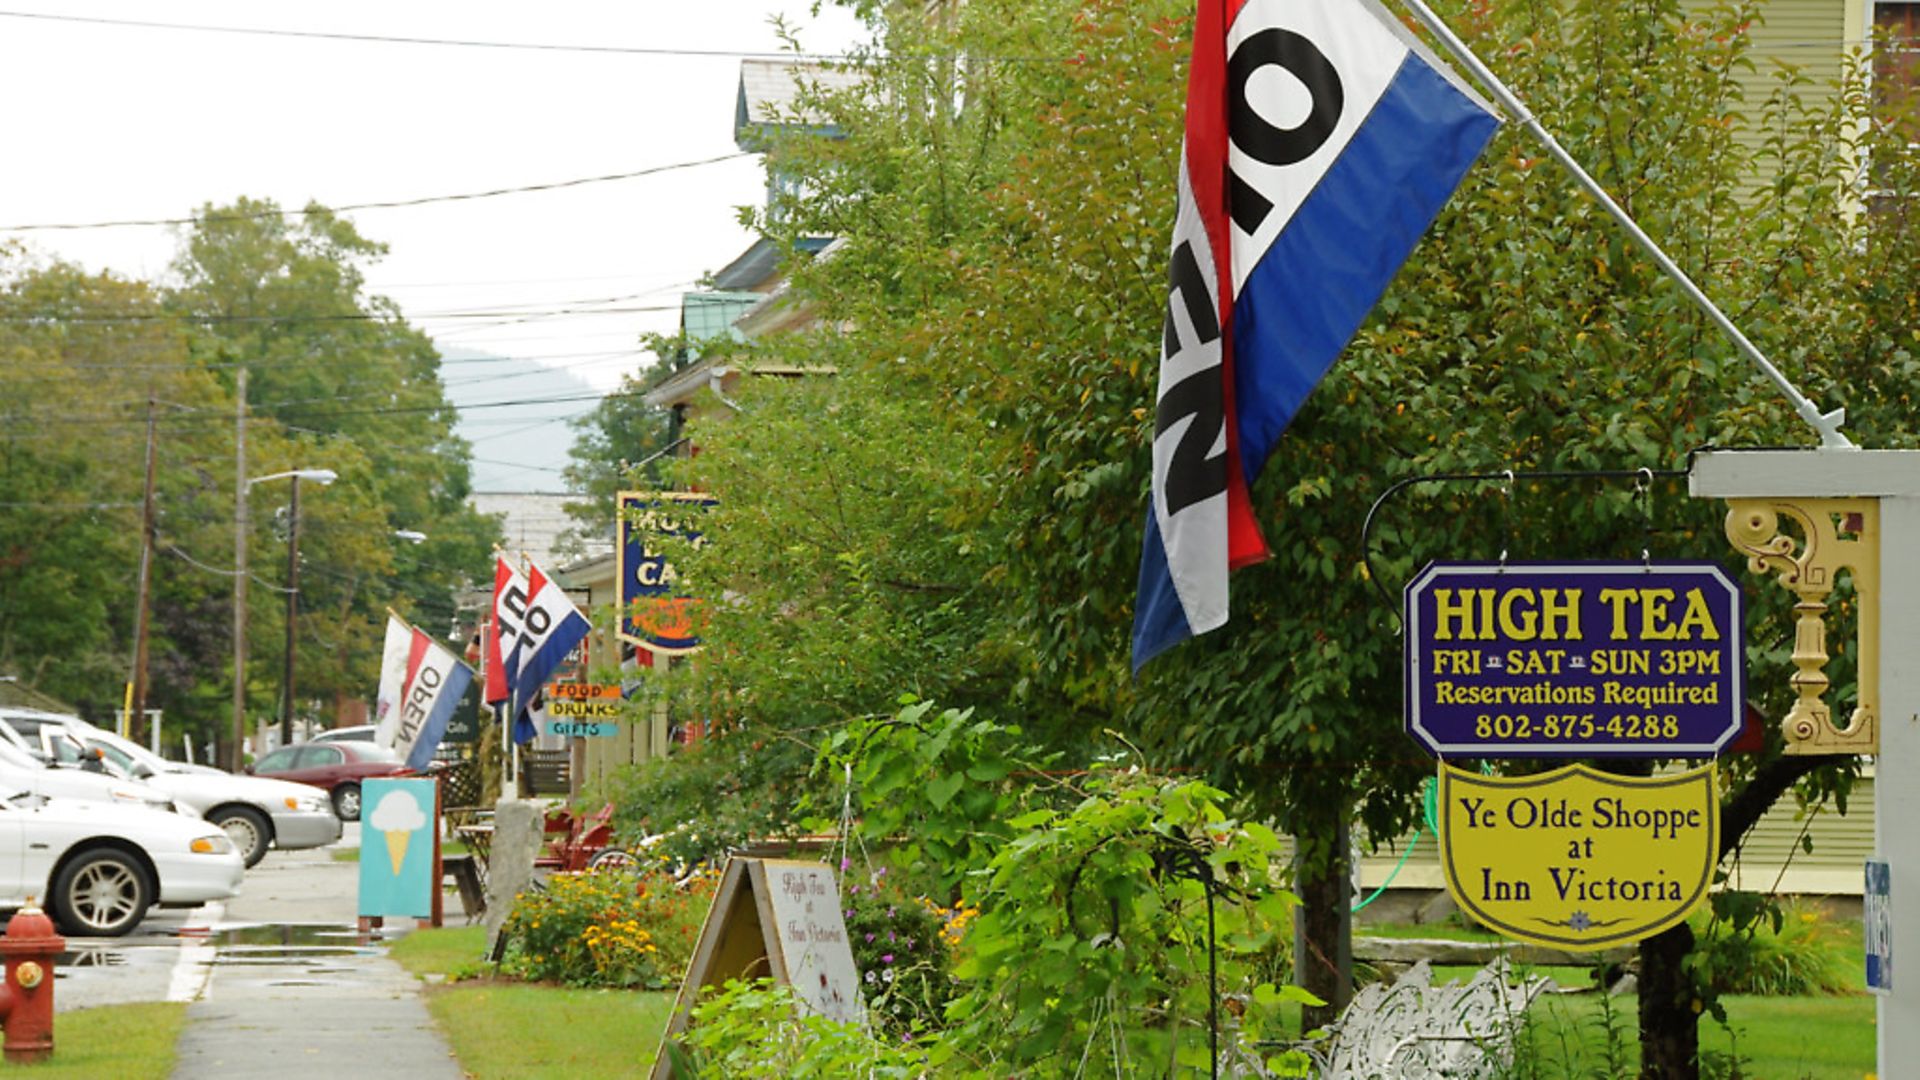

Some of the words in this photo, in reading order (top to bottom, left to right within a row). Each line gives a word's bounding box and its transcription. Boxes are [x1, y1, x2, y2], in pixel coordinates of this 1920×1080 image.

[1433, 587, 1583, 641] HIGH
[1599, 587, 1720, 641] TEA
[1432, 649, 1482, 675] FRI
[1505, 649, 1566, 675] SAT
[1590, 649, 1651, 675] SUN
[1659, 649, 1721, 675] 3PM
[555, 684, 602, 697] FOOD
[1435, 681, 1596, 705] Reservations
[1602, 680, 1719, 709] Required
[553, 702, 618, 716] DRINKS
[553, 722, 600, 736] GIFTS
[1475, 714, 1679, 738] 802-875-4288
[1459, 798, 1496, 828] Ye
[1506, 797, 1582, 829] Olde
[1592, 797, 1700, 839] Shoppe
[1568, 837, 1594, 859] at
[1481, 867, 1531, 901] Inn
[1548, 866, 1682, 901] Victoria
